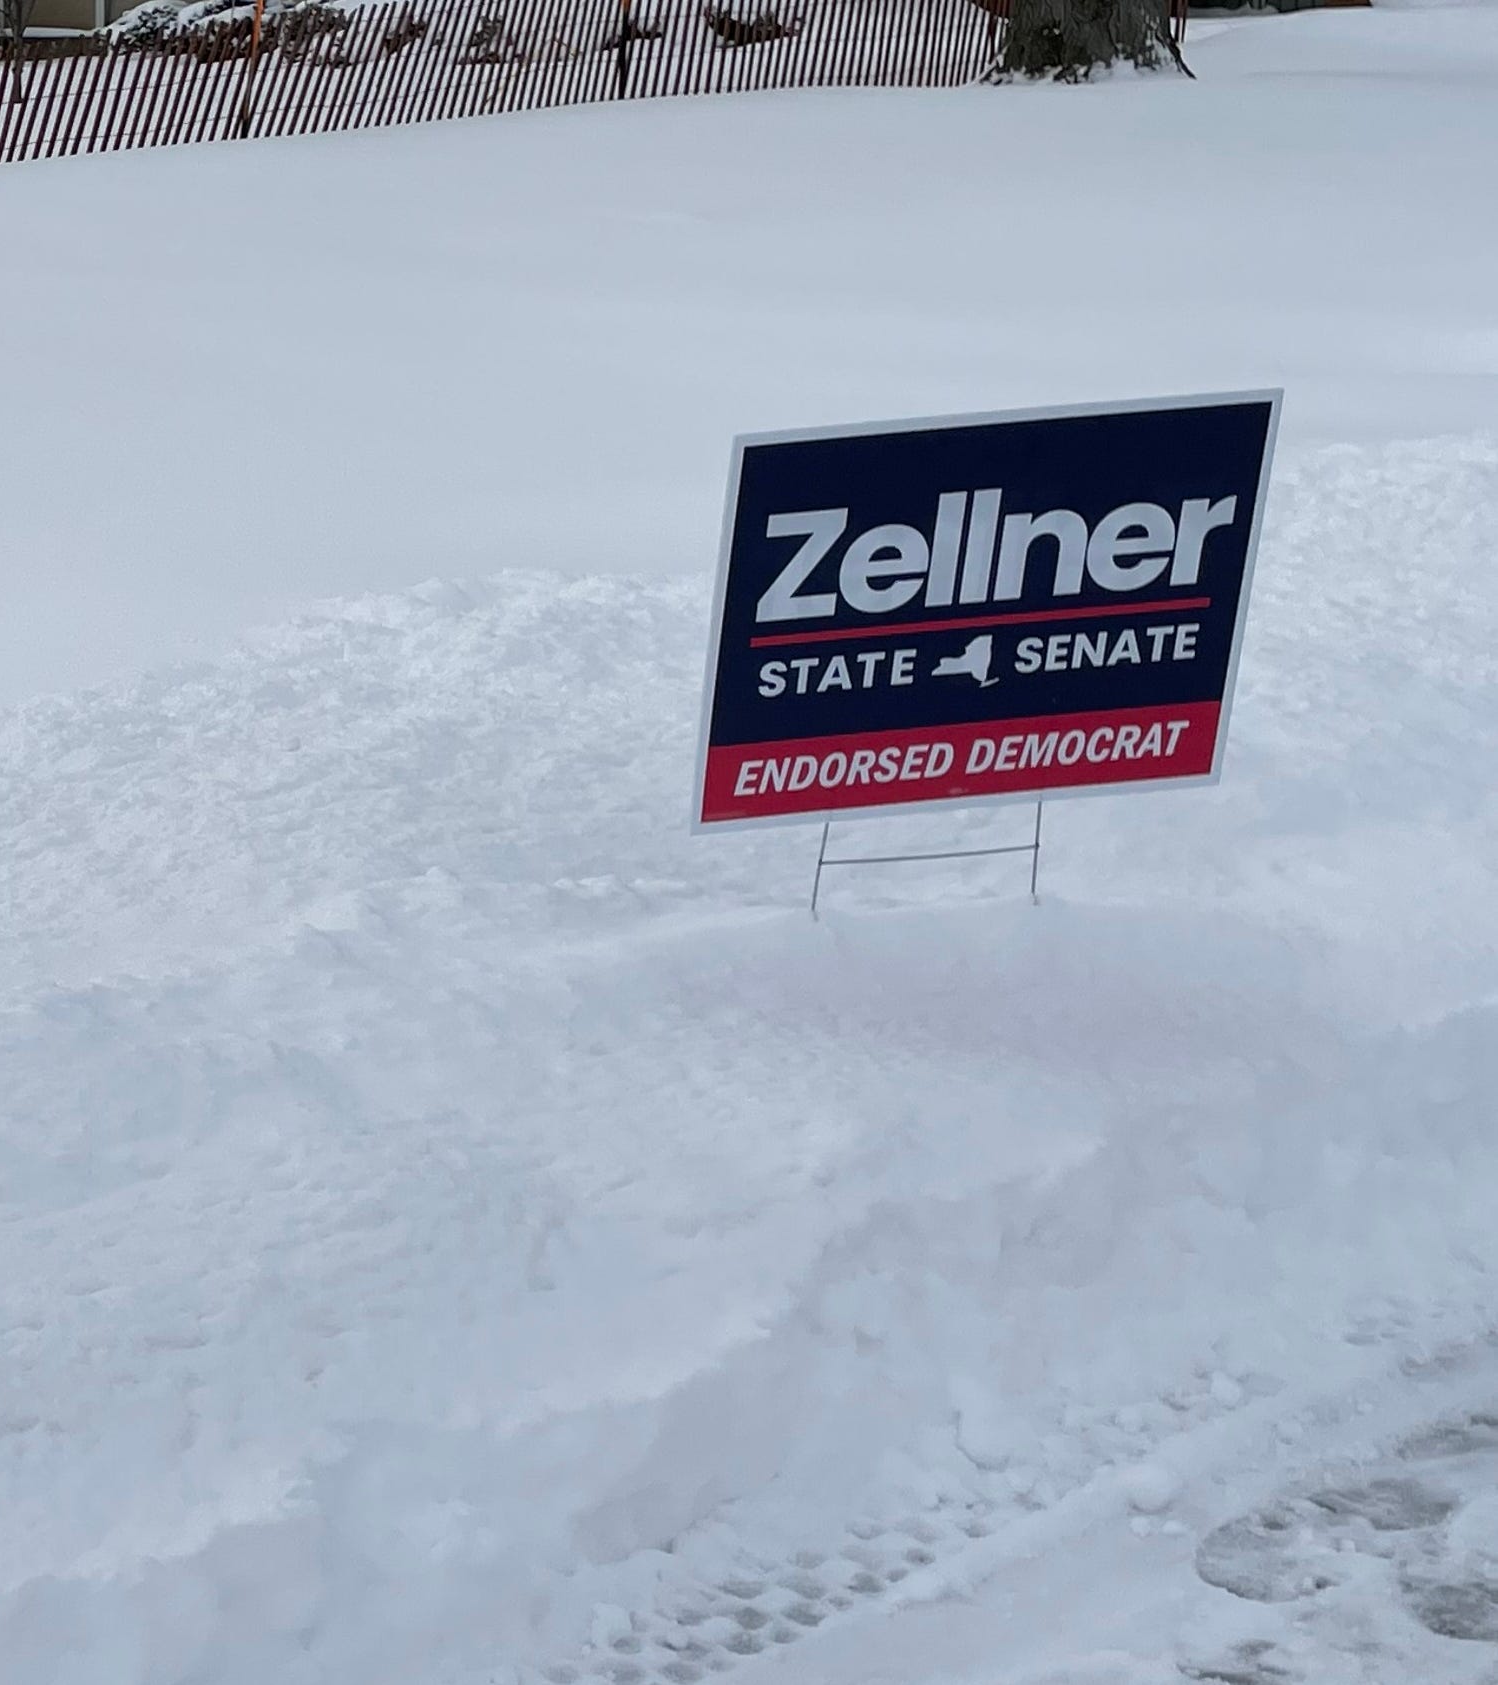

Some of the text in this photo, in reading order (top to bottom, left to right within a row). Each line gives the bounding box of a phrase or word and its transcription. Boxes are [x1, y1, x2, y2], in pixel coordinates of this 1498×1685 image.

[755, 487, 1238, 624] Zellner
[757, 622, 1201, 697] STATE SENATE
[733, 719, 1190, 797] ENDORSED DEMOCRAT
